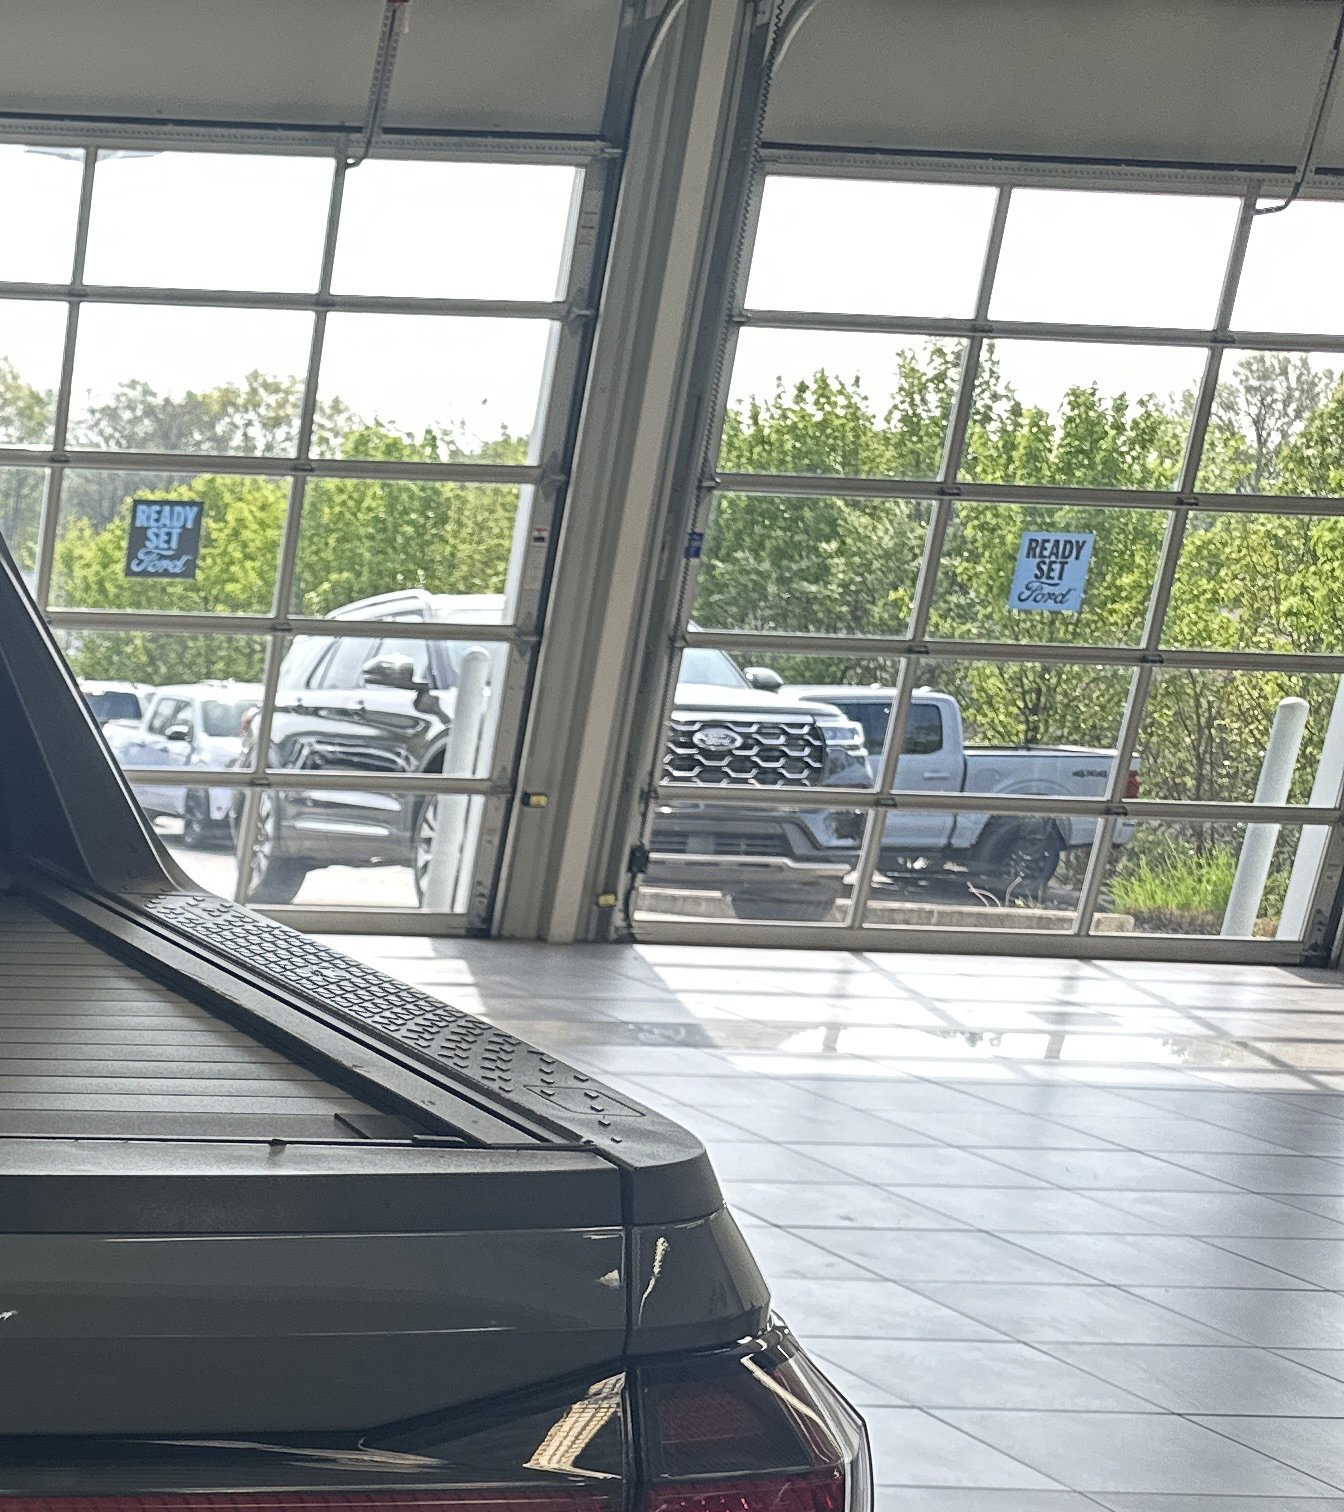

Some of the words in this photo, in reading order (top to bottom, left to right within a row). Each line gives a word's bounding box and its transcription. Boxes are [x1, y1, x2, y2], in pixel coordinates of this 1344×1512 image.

[135, 504, 199, 528] READY
[144, 528, 182, 549] SET
[1025, 538, 1087, 560] READY
[130, 548, 192, 573] Ford
[1034, 560, 1068, 580] SET
[1017, 580, 1077, 604] Ford
